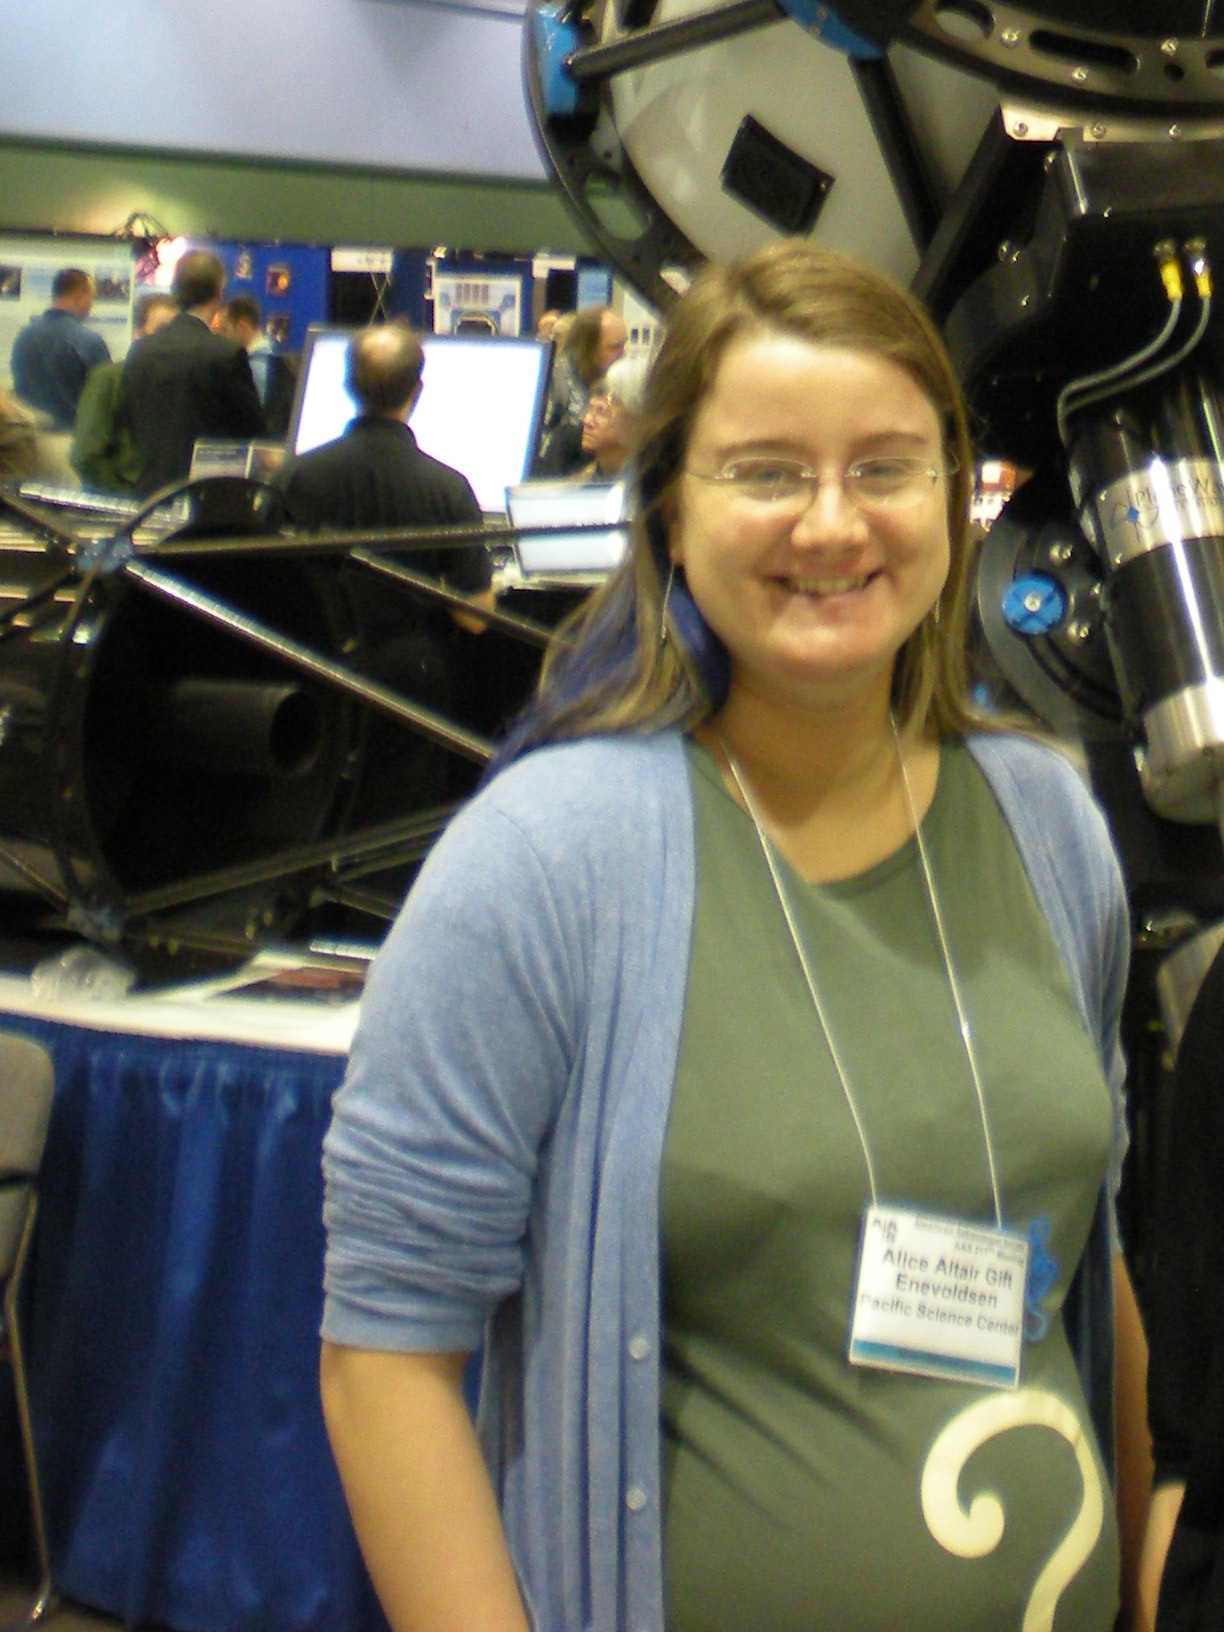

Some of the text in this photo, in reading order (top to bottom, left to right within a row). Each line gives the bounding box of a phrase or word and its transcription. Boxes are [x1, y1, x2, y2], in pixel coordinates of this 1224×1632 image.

[882, 1248, 1013, 1289] Alice Altair Gift
[895, 1273, 998, 1308] Enevoldsen
[916, 1303, 972, 1328] Science
[976, 1315, 1020, 1336] Center
